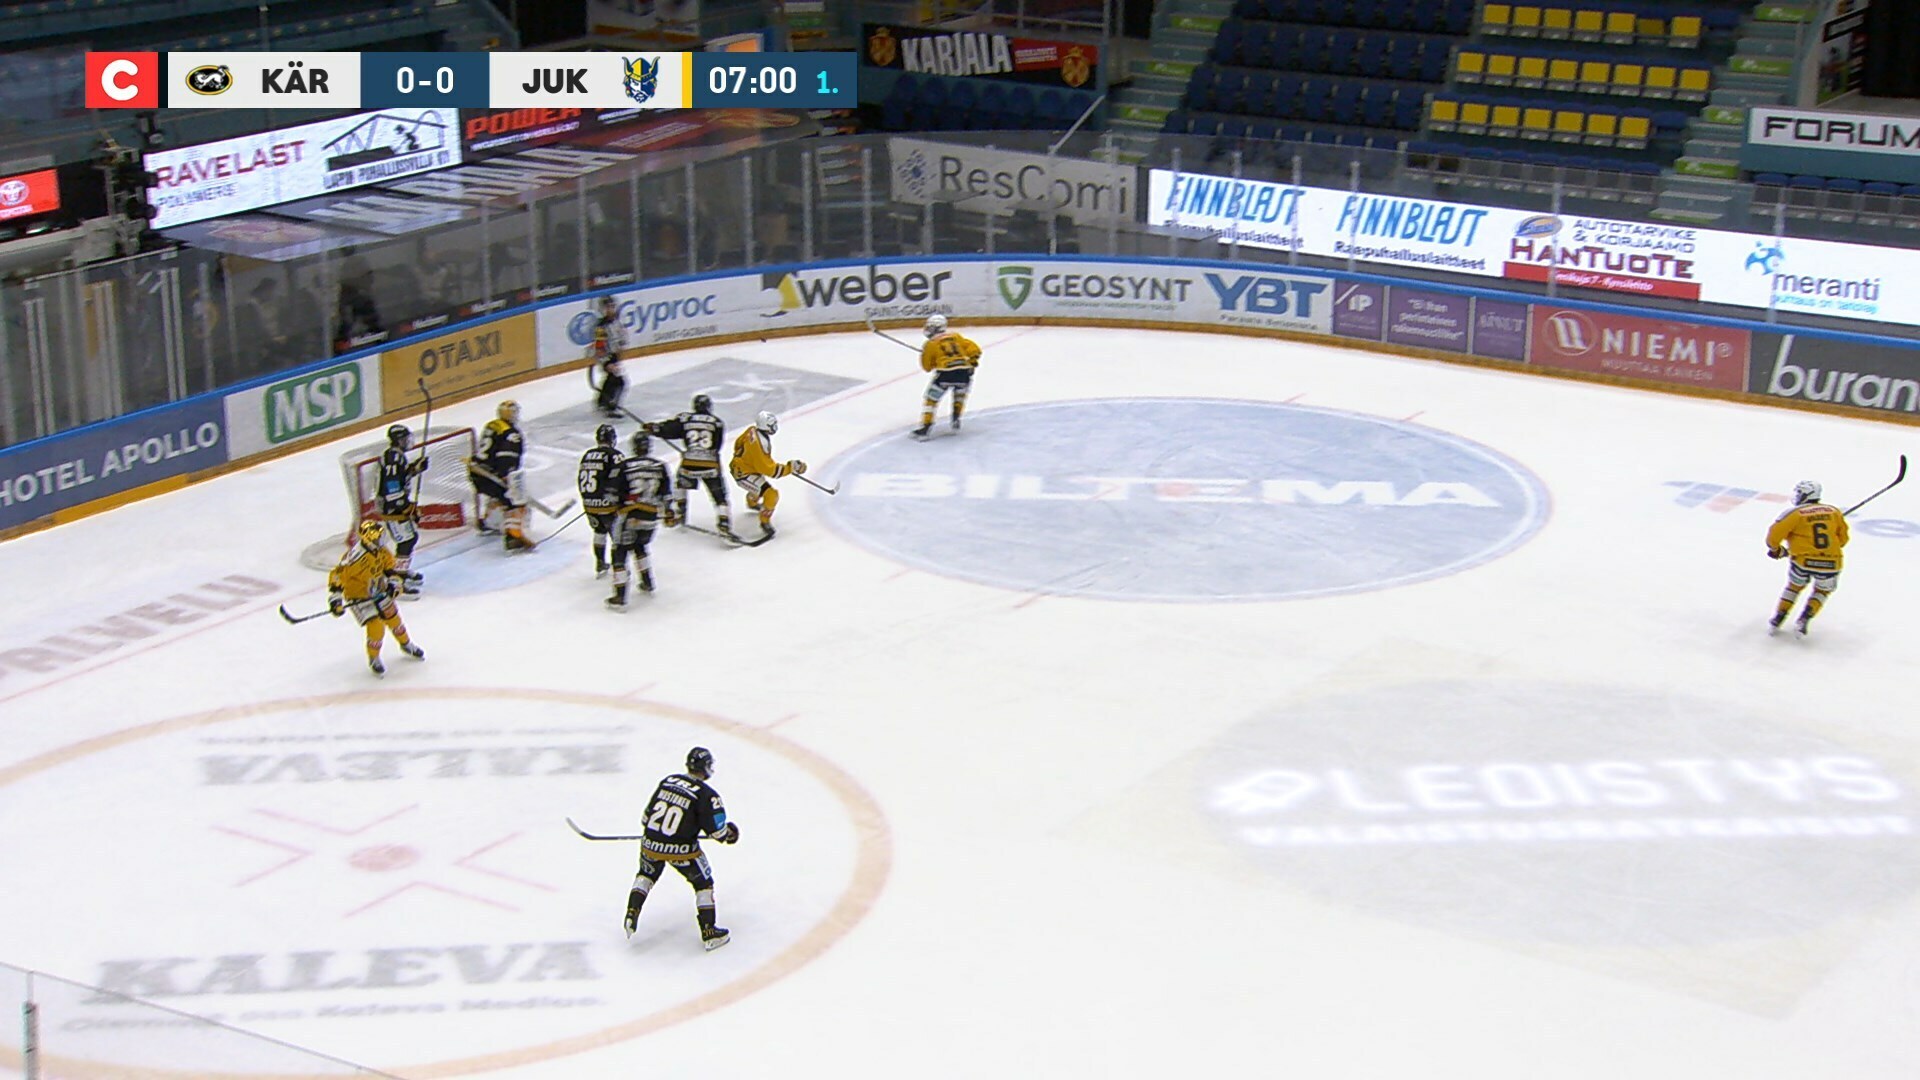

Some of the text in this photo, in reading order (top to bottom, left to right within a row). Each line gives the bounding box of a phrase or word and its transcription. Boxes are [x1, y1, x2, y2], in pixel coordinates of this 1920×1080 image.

[901, 32, 1013, 77] KARJALA
[1764, 116, 1920, 148] FORUM
[155, 139, 307, 189] RAVELAST
[1164, 175, 1305, 226] FINNBLAST
[1336, 196, 1489, 247] FINNBLAST
[1573, 217, 1697, 241] AUTOTARVIKE
[1595, 232, 1696, 254] KORJAAMO
[1510, 237, 1696, 280] HANTUOTE
[797, 265, 952, 308] weber
[1040, 273, 1193, 302] GEOSYNT
[1204, 272, 1328, 318] YBT
[1775, 271, 1881, 302] meranti
[616, 293, 717, 335] Gyproc
[419, 330, 503, 376] OTAXI
[1766, 334, 1920, 415] buran
[271, 371, 358, 439] MSP
[101, 421, 220, 479] APOLLO
[579, 469, 598, 494] 25
[851, 472, 1501, 507] BILTEMA
[1813, 522, 1830, 550] 6
[197, 744, 631, 786] KALEVA
[647, 800, 684, 837] 20
[82, 940, 603, 1005] KALEVA
